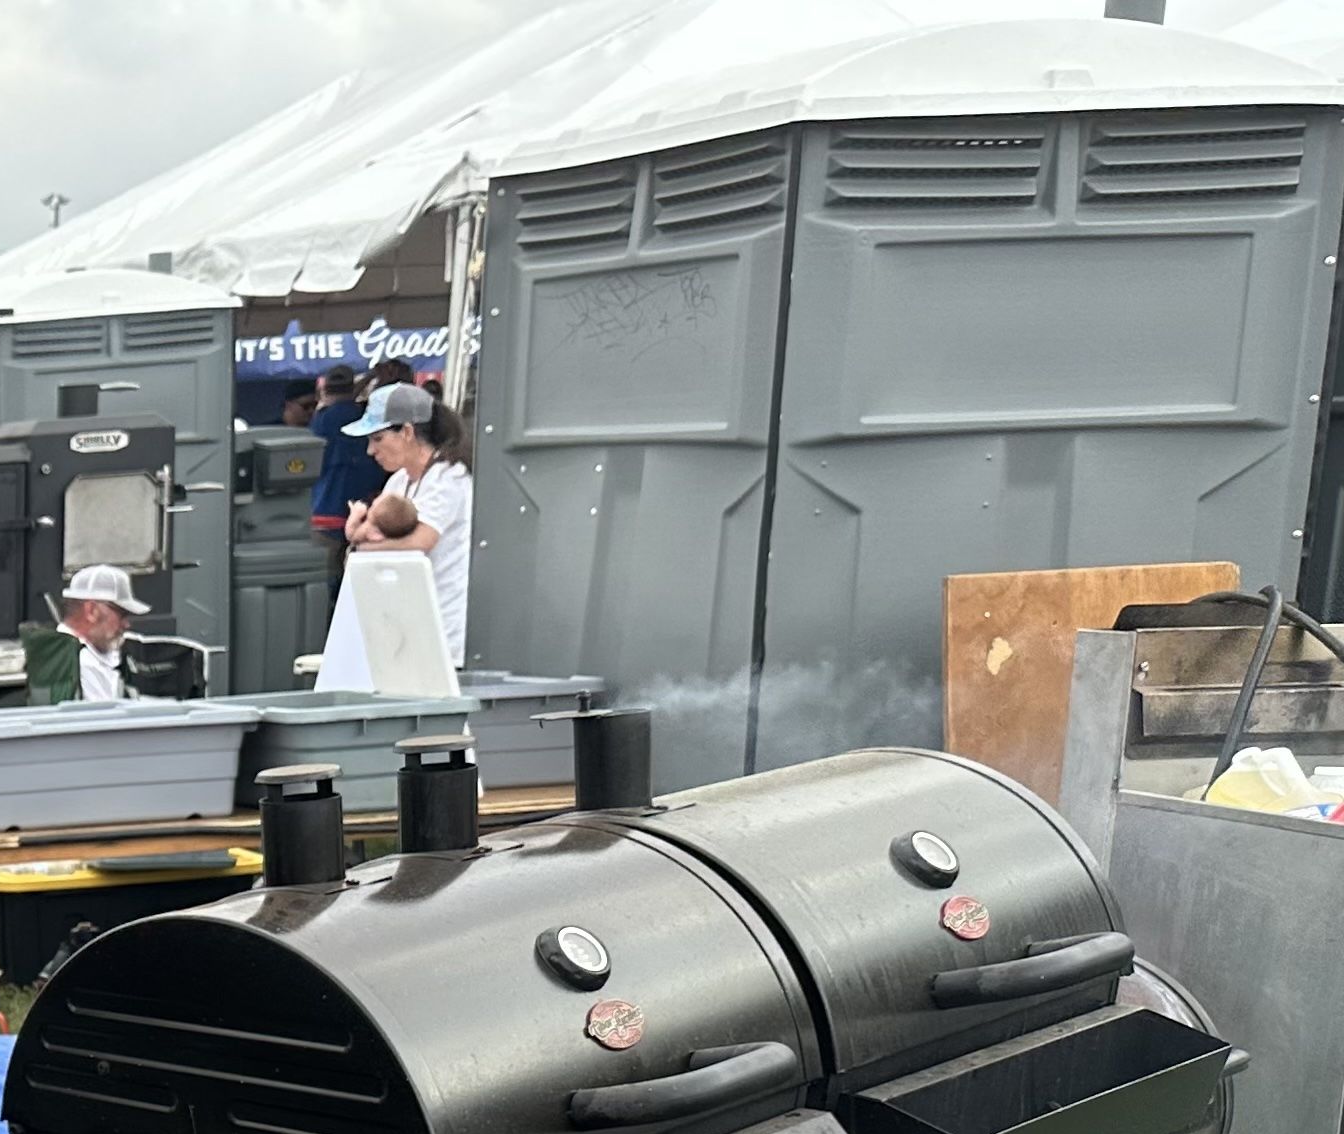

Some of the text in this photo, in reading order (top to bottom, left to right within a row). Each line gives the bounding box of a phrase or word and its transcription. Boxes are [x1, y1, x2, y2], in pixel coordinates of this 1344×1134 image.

[235, 336, 285, 363] IT'S
[290, 332, 345, 360] THE
[353, 317, 450, 370] Good
